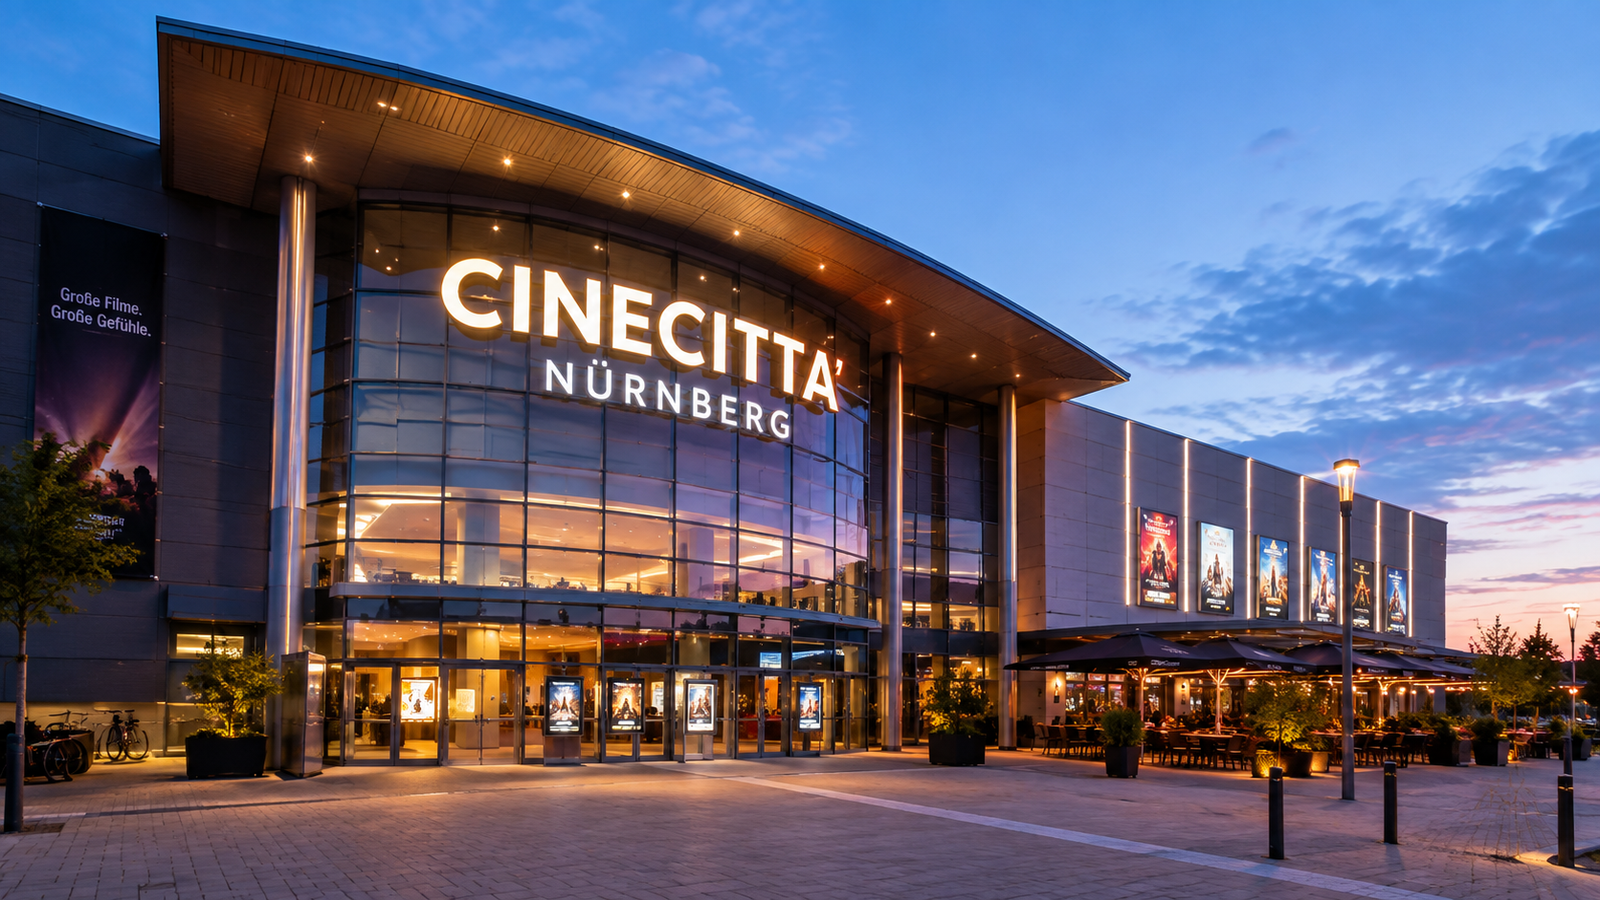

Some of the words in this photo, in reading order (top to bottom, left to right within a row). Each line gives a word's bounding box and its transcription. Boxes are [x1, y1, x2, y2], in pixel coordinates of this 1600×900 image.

[60, 287, 100, 307] Große
[105, 296, 142, 316] Filme.
[51, 304, 93, 325] Große
[97, 313, 151, 337] Gefühle.
[545, 358, 791, 439] NÜRNBERG
